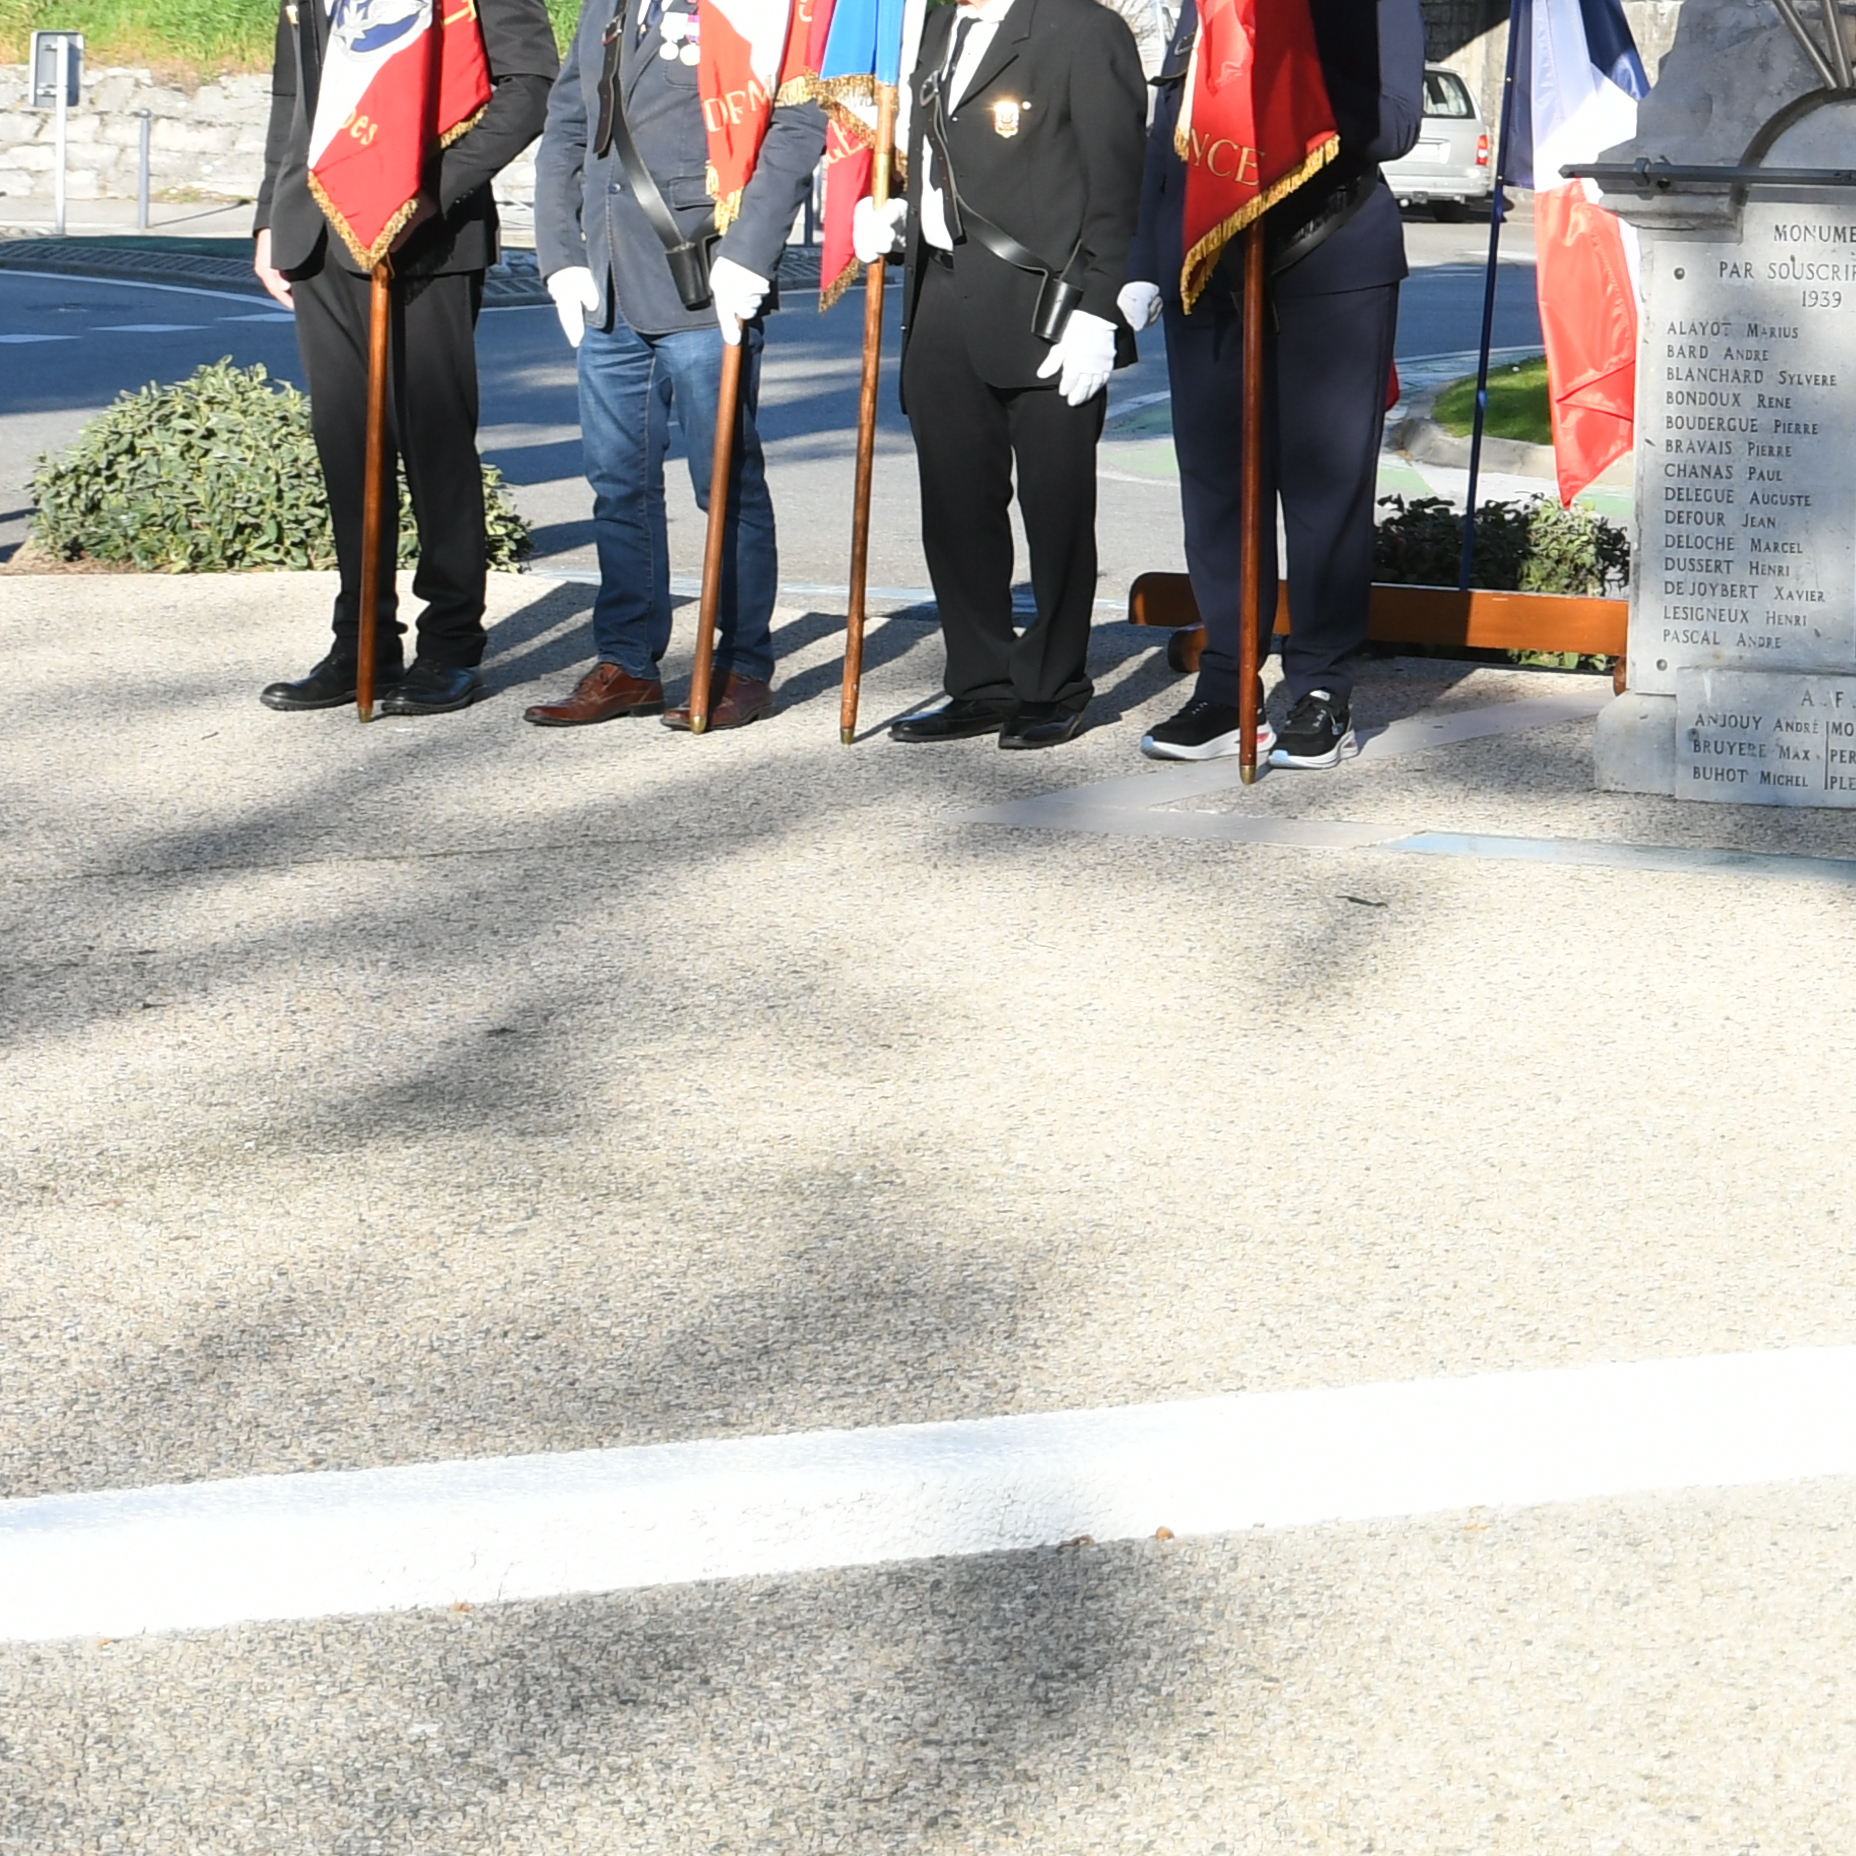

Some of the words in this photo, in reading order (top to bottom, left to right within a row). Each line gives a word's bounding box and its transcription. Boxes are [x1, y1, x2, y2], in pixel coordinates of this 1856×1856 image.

[1719, 262, 1755, 279] PAR
[1801, 291, 1843, 309] 1939
[1667, 346, 1708, 360] BARD
[1724, 347, 1769, 362] ANDRE
[1667, 368, 1763, 384] BLANCHARD
[1778, 370, 1837, 387] SYLVERE
[1666, 391, 1741, 408] BONDOUX
[1757, 395, 1792, 409] RENE
[1666, 415, 1758, 433] BOUDERGUE
[1774, 420, 1818, 435] PIERRE
[1665, 440, 1733, 456] BRAVAIS
[1748, 443, 1792, 457] PIERRE
[1664, 464, 1734, 481] CHANAS
[1748, 467, 1782, 482] PAUL
[1749, 491, 1811, 507] AUGUSTE
[1665, 510, 1725, 527] DEFOUR
[1741, 513, 1776, 529] JEAN
[1664, 535, 1734, 551] DELOCHE
[1750, 539, 1803, 554] MARCEL
[1664, 558, 1734, 575] DUSSERT
[1749, 562, 1790, 577] HENRI
[1774, 587, 1825, 603] XAVIER
[1663, 607, 1749, 624] LESIGNEUX
[1766, 611, 1807, 627] HENRI
[1663, 630, 1720, 645] PASCAL
[1695, 714, 1762, 730] ANJOUY
[1779, 745, 1810, 761] MAX
[1692, 766, 1748, 783] BUHOT
[1759, 770, 1808, 788] MICHEL
